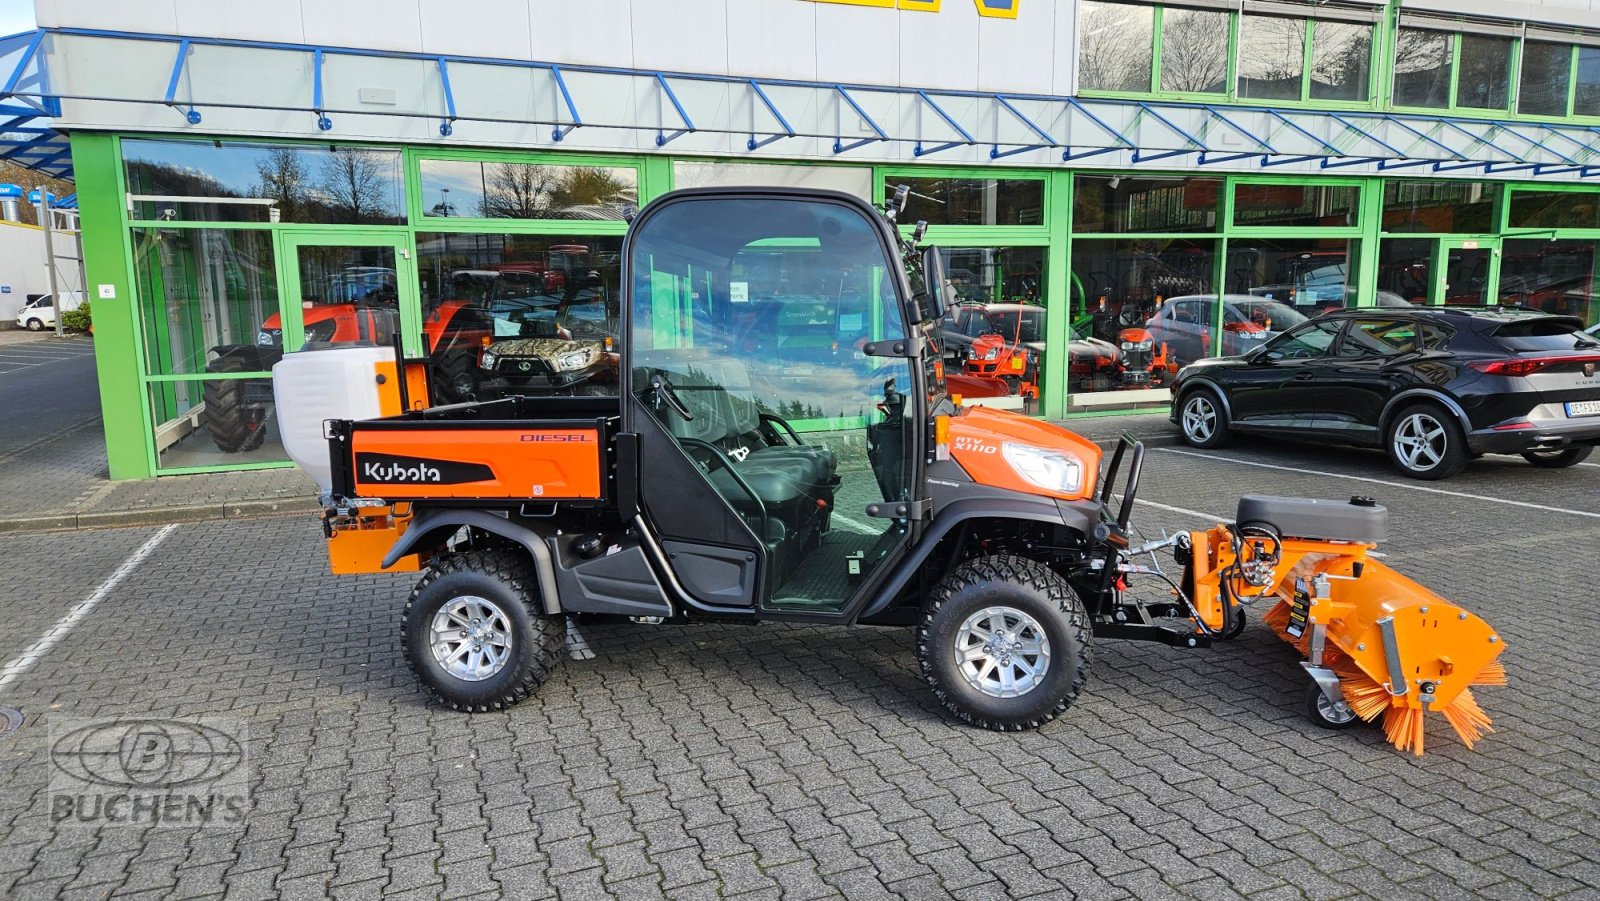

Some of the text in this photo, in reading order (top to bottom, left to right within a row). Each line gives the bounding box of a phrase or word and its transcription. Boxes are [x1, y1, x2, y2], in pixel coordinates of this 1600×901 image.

[519, 434, 593, 443] DIESEL
[954, 443, 997, 454] X1110
[364, 462, 441, 482] Kubota
